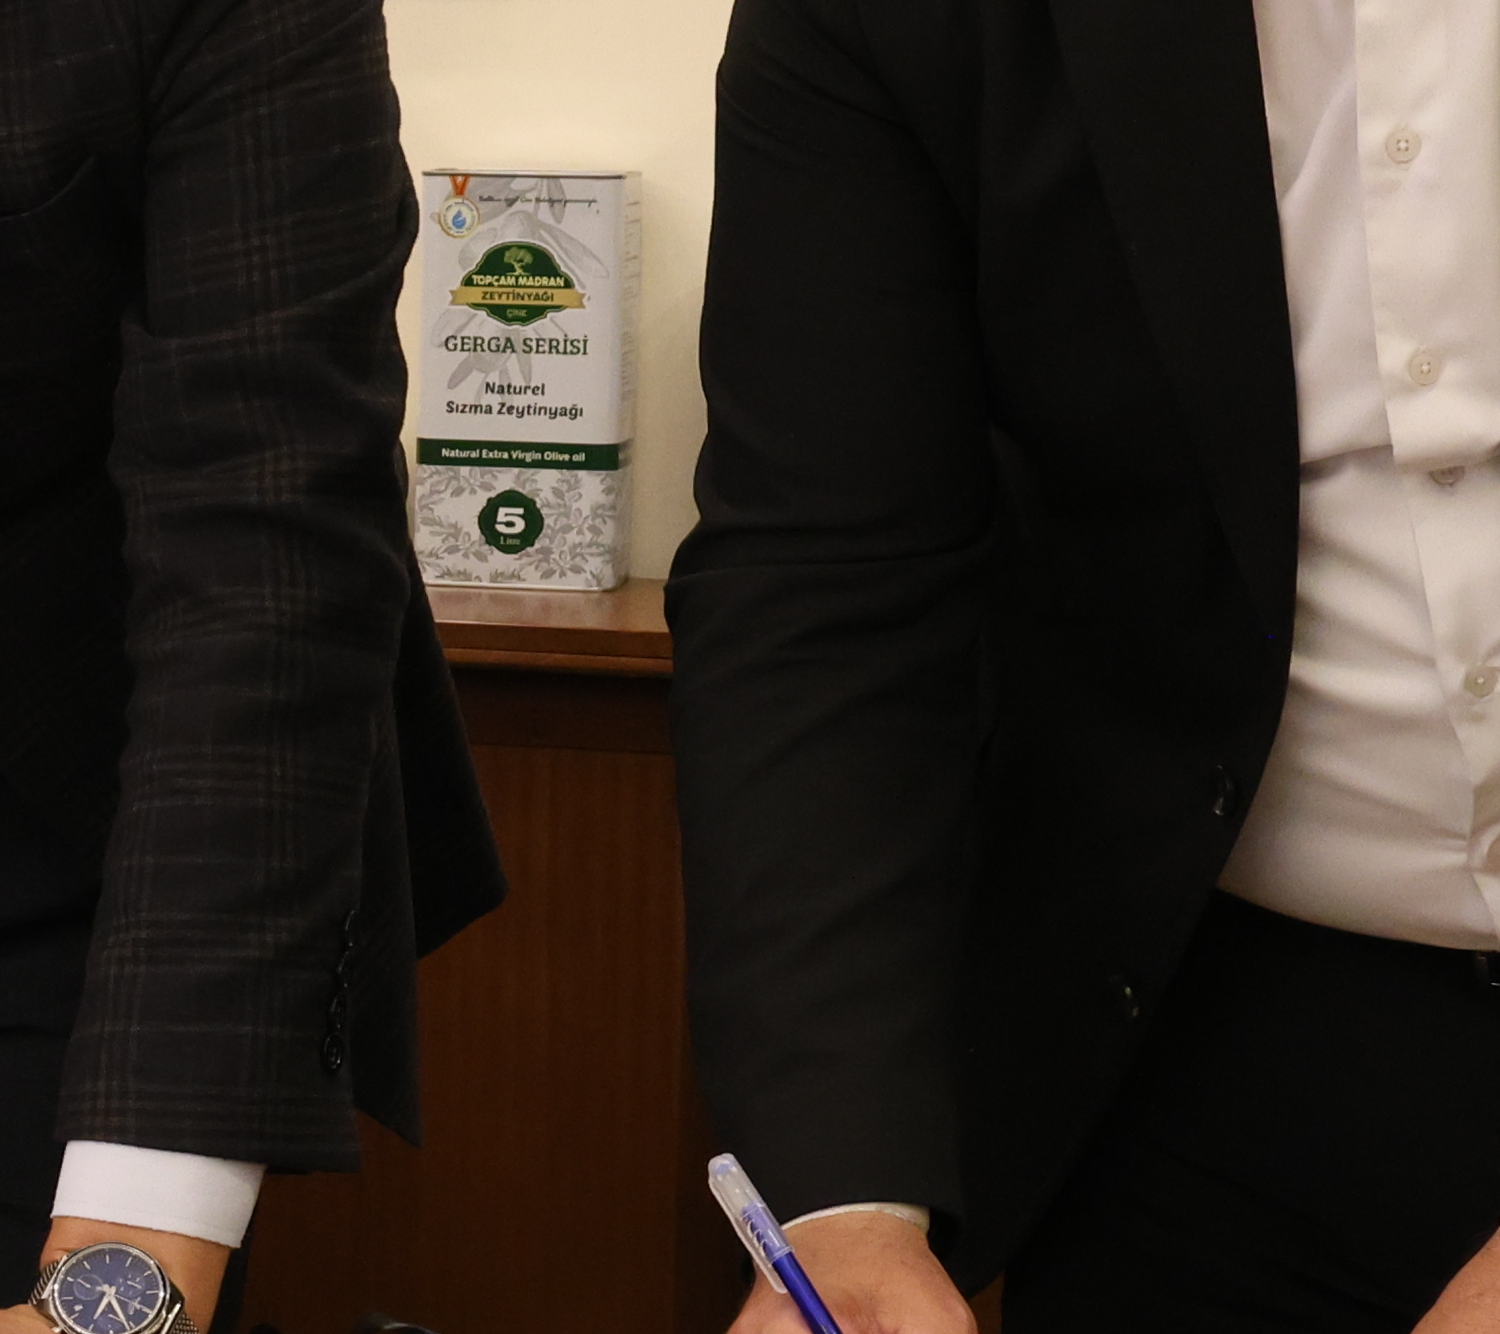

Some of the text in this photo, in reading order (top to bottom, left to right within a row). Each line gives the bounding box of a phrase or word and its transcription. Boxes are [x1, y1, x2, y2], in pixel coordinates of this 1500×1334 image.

[471, 275, 565, 287] TOPÇAM MADRAN
[481, 290, 554, 302] ZEYTİNYAĞI
[444, 333, 589, 355] GERGA SERİSİ
[485, 382, 546, 396] Naturel
[446, 401, 584, 421] Sızma Zeytinyağı
[442, 448, 586, 462] Natural Extra Virgin Olive oil
[495, 507, 526, 535] 5
